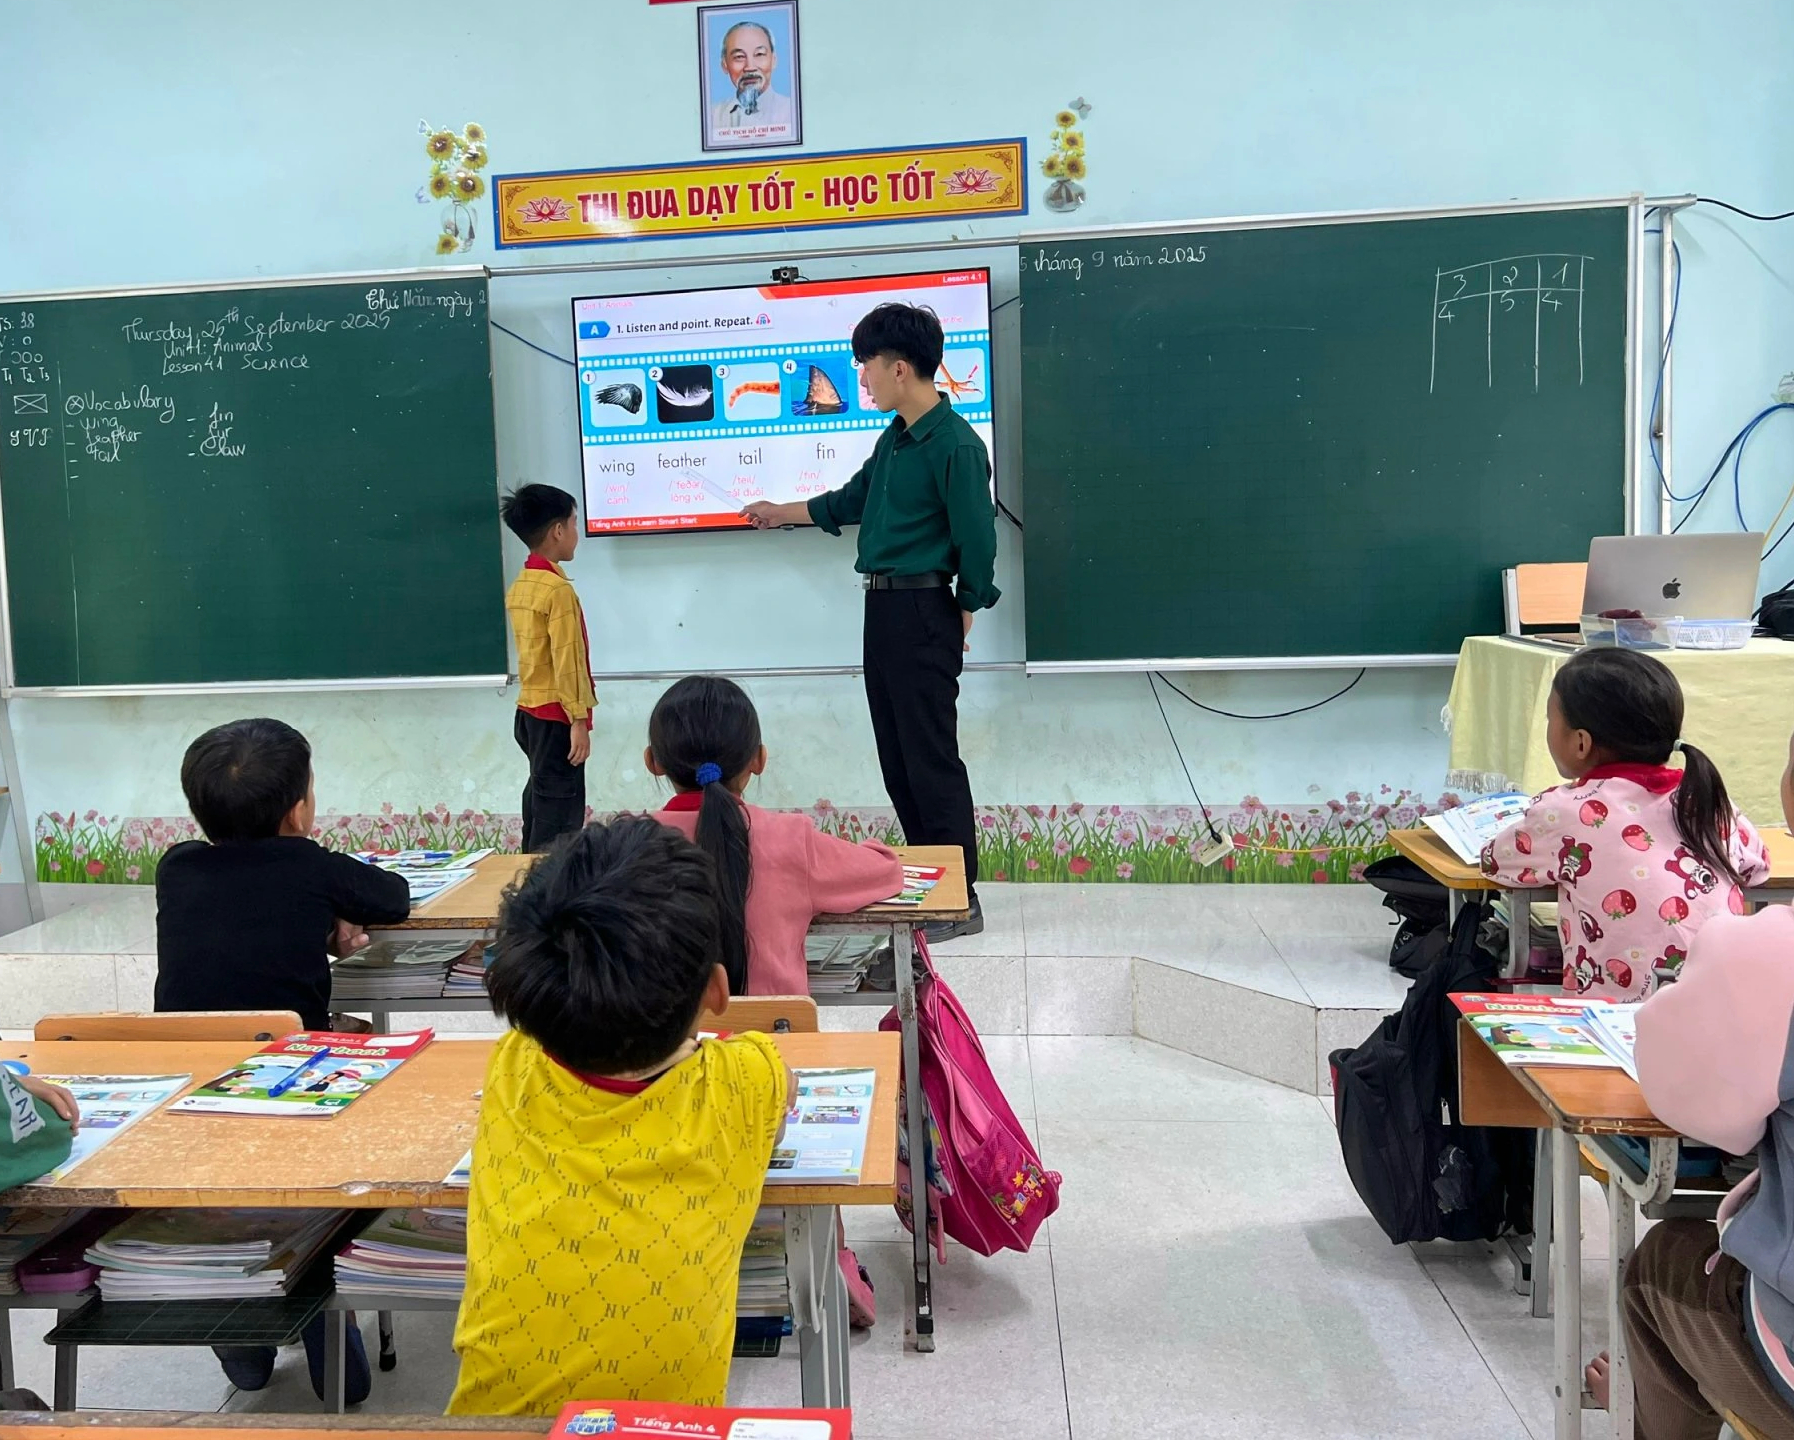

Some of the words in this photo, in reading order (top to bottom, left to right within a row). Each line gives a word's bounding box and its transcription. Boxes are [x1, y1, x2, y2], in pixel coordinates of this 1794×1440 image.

[577, 192, 618, 223] THI
[627, 185, 680, 220] ĐUA
[687, 182, 738, 216] DẠY
[747, 170, 796, 211] TỐT
[823, 176, 878, 212] HỌC
[886, 160, 936, 202] TỐT
[1033, 249, 1085, 281] tháng
[1091, 250, 1104, 268] 9
[1112, 250, 1154, 268] năm
[1157, 245, 1209, 264] 2025
[943, 275, 969, 283] Lesson
[1453, 274, 1467, 297] 3
[1502, 266, 1519, 287] 2
[437, 290, 474, 318] ngày
[1438, 303, 1456, 324] 4
[1500, 290, 1515, 312] 5
[1541, 291, 1563, 312] 4
[243, 311, 335, 340] September
[340, 310, 391, 330] 2025
[590, 325, 599, 335] A
[617, 325, 624, 334] 1.
[626, 322, 656, 333] Listen
[658, 320, 678, 331] and
[680, 319, 712, 332] point.
[714, 316, 753, 329] Repeat.
[213, 332, 273, 356] Animals
[162, 357, 202, 376] Lesson
[241, 353, 310, 371] Science
[719, 368, 726, 376] 3
[786, 362, 794, 372] 4
[652, 370, 658, 378] 2
[84, 384, 176, 424] Vocabulary
[658, 452, 707, 468] feather
[738, 447, 762, 466] tail
[816, 442, 836, 460] fin
[599, 460, 635, 476] wing
[634, 1416, 671, 1430] Tiếng
[674, 1421, 704, 1432] Anh
[705, 1424, 716, 1434] 4
